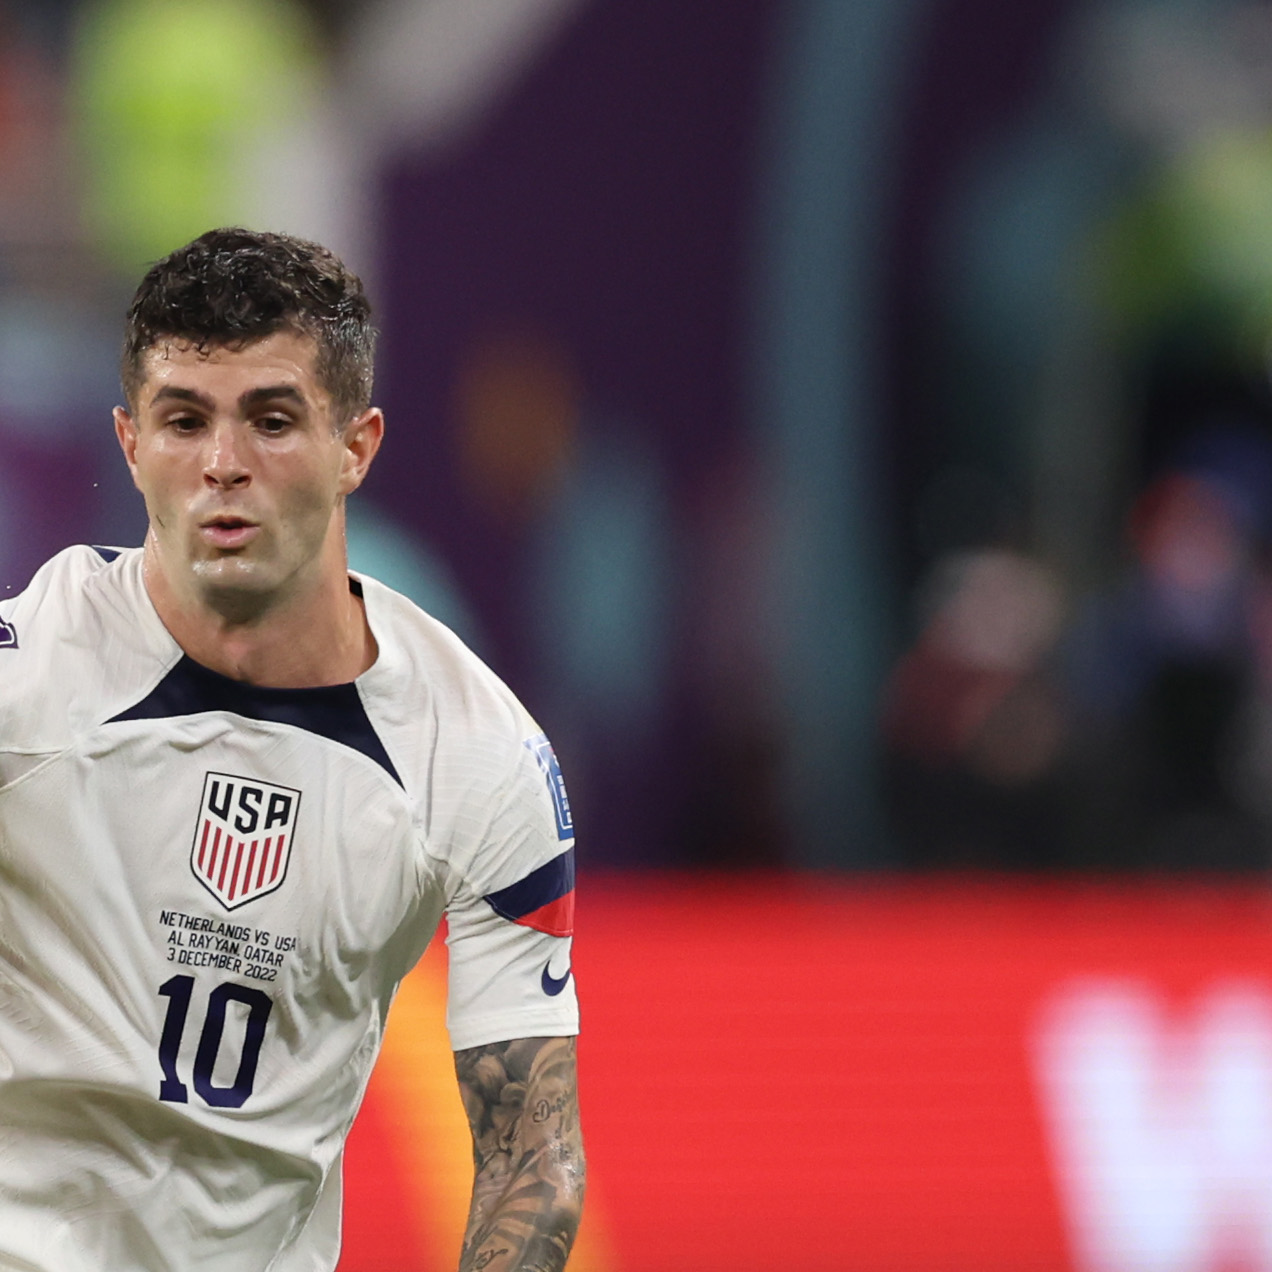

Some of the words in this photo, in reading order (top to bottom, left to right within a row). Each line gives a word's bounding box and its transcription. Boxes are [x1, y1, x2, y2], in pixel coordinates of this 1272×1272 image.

[208, 780, 293, 834] USA
[159, 910, 252, 942] NETHERLANDS
[255, 928, 271, 946] VS
[274, 936, 297, 952] USA
[167, 930, 184, 946] AL
[244, 944, 284, 968] QATAR
[166, 947, 176, 962] 3
[178, 949, 242, 974] DECEMBER
[243, 963, 278, 982] 2022
[158, 974, 274, 1109] 10
